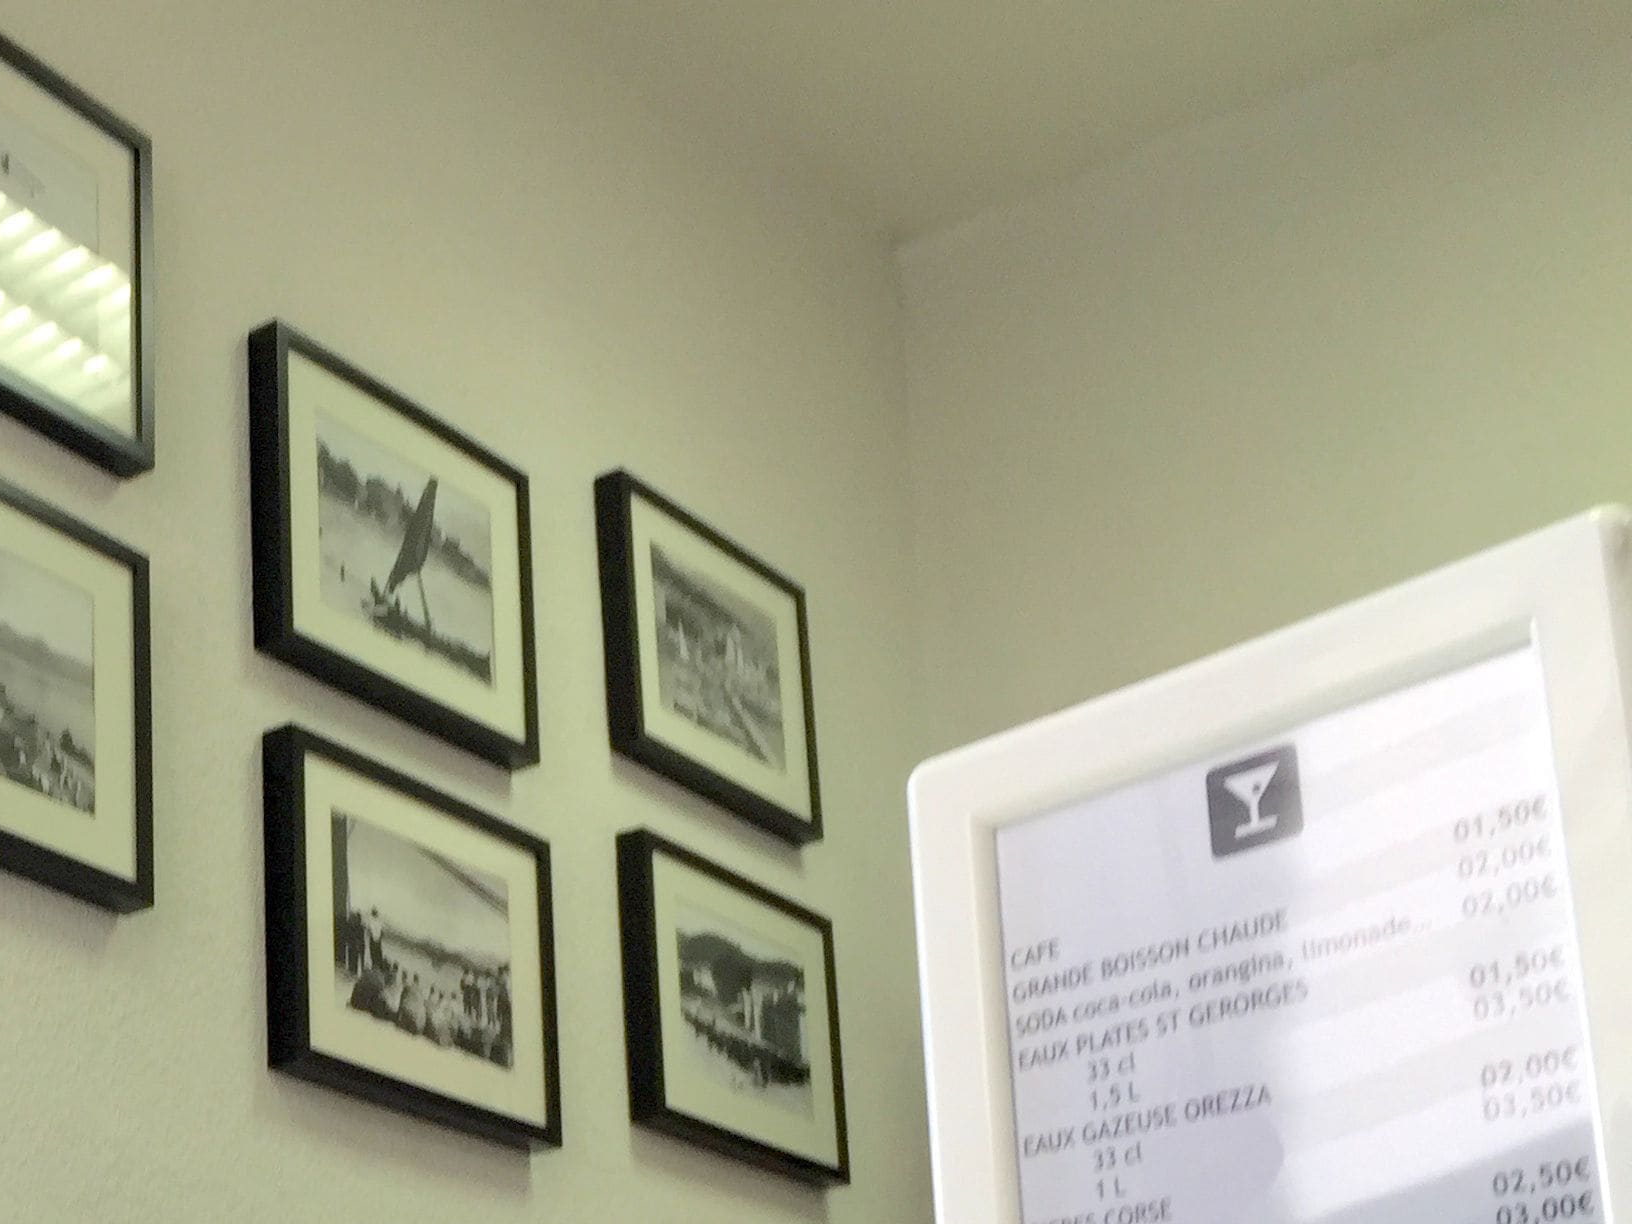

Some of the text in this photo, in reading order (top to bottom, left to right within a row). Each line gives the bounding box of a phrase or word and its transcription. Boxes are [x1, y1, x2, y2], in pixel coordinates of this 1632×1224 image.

[1454, 794, 1546, 843] 01,50€
[1011, 936, 1059, 971] CAFE
[1013, 907, 1288, 1003] GRANDE BOISSON CHAUDE
[1470, 943, 1565, 988] 01,50€
[1017, 1007, 1067, 1038] SODA
[1188, 951, 1293, 992] orangina,
[1474, 978, 1568, 1021] 03,50€
[1019, 1041, 1068, 1073] EAUX
[1076, 1016, 1150, 1055] PLATES
[1157, 1009, 1180, 1038] ST
[1088, 1051, 1136, 1083] 33 cl
[1481, 1045, 1576, 1088] 02,00€
[1091, 1081, 1139, 1111] 1,5 L
[1024, 1085, 1272, 1158] EAUX GAZEUSE OREZZA
[1094, 1140, 1143, 1172] 33 cl
[1493, 1155, 1590, 1197] 02,50€
[1097, 1175, 1126, 1200] 1 L
